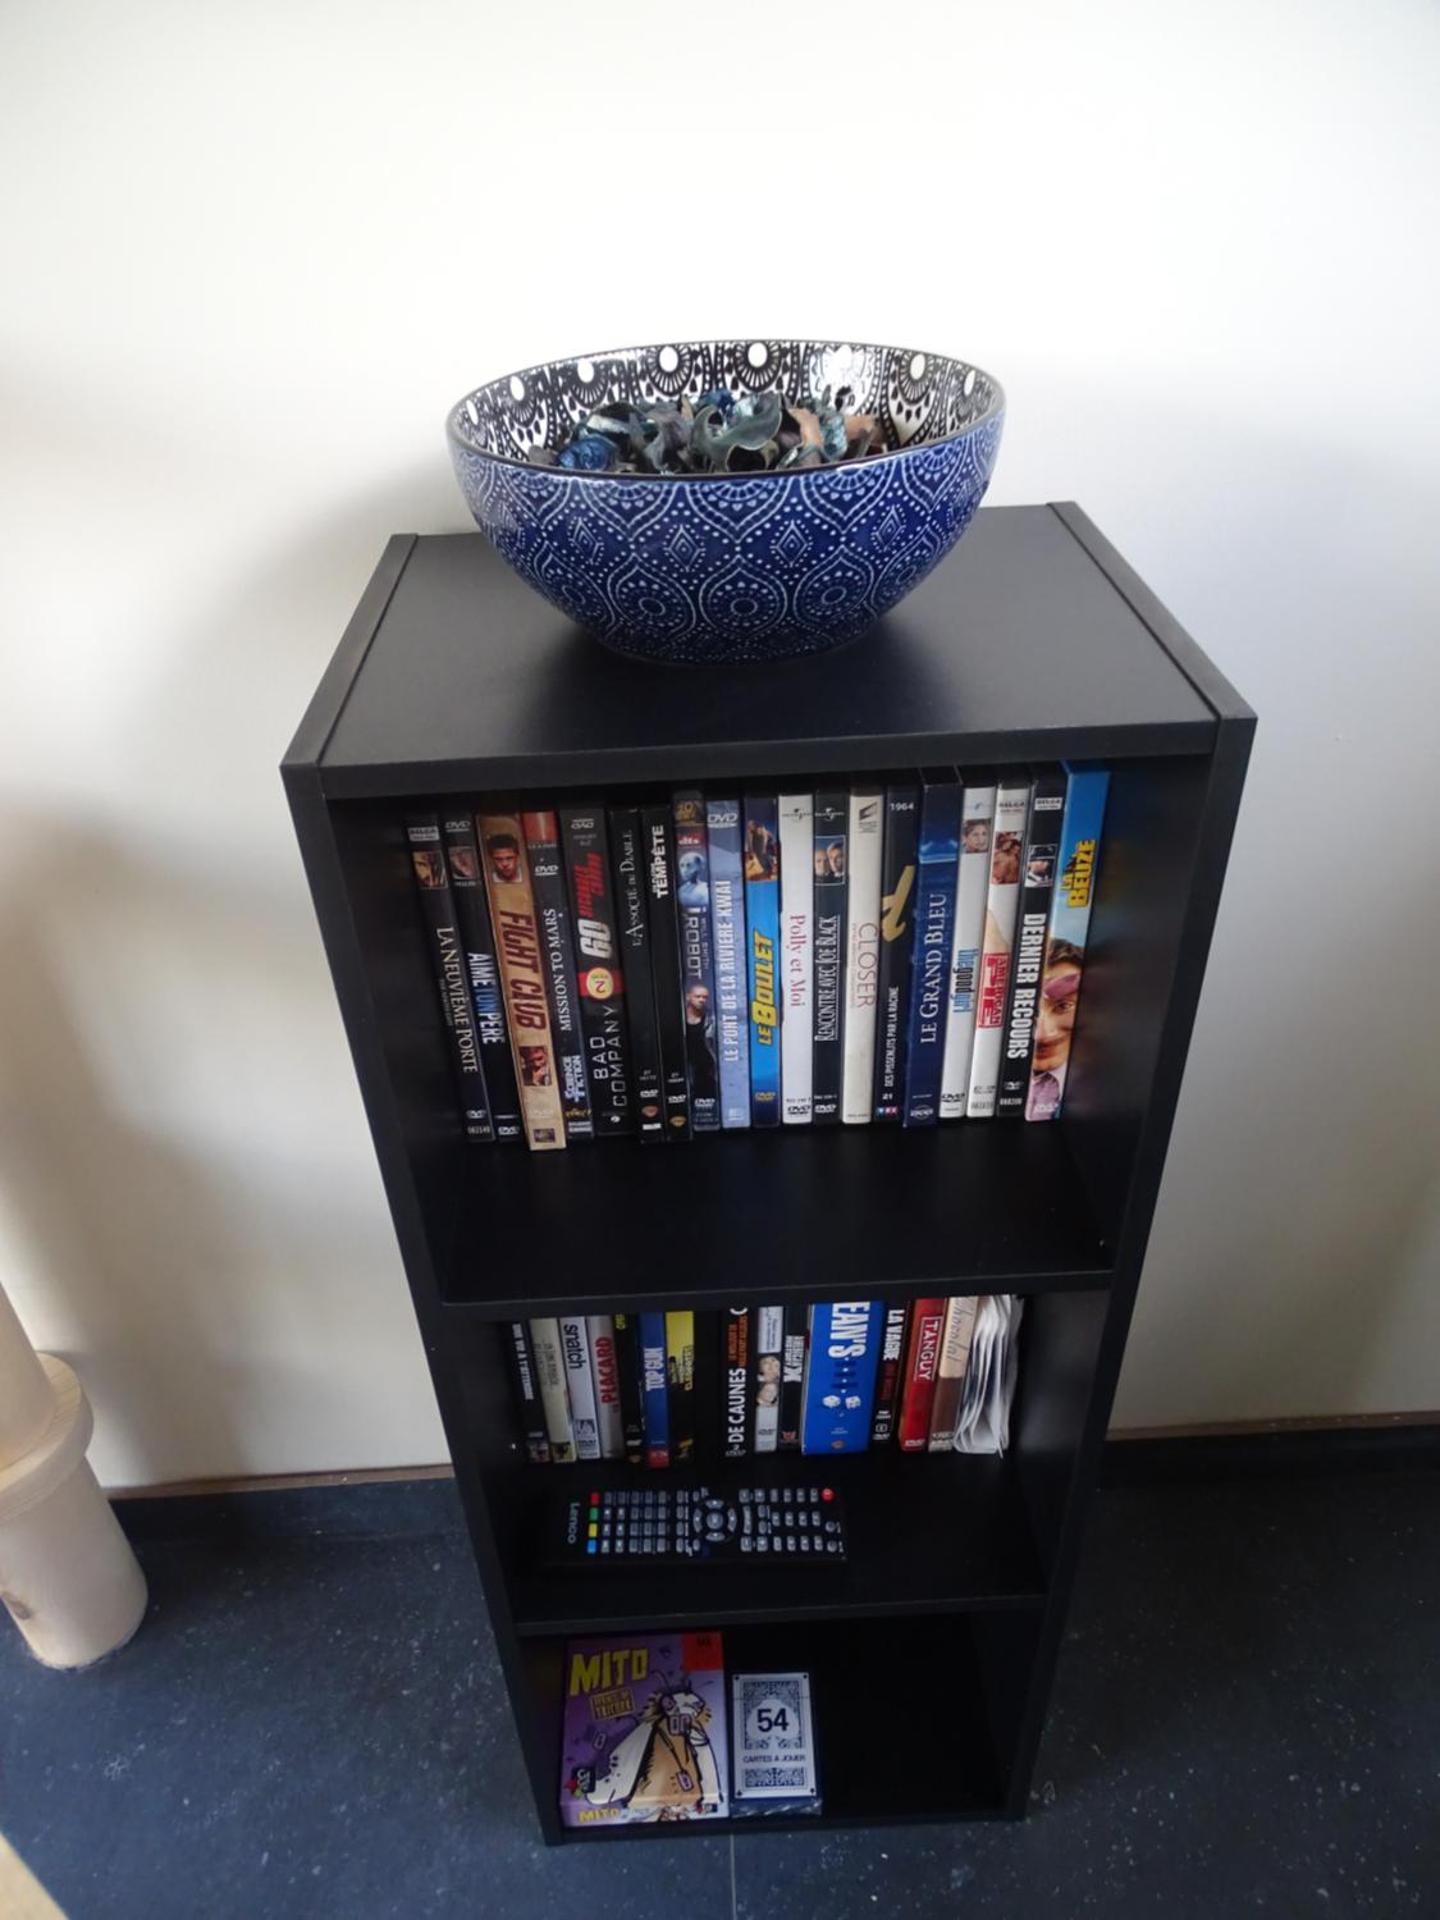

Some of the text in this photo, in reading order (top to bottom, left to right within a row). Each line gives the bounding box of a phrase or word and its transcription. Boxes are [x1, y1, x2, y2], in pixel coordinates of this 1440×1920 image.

[707, 813, 738, 827] DVD
[651, 825, 669, 899] TEMPÊTE
[1067, 839, 1097, 908] BEUZE
[500, 911, 547, 1030] FIGHT CLUB
[543, 909, 572, 1031] MISSION TO MARS
[577, 919, 612, 959] 60
[685, 915, 703, 979] ROBOT
[715, 880, 739, 1062] LE PONT DE LA RIVIERE KWAI
[786, 915, 807, 1007] Polly et Moi
[856, 922, 878, 1008] CLOSER
[920, 894, 947, 1043] LE GRAND BLEU
[1016, 913, 1047, 984] DERNIER
[436, 926, 455, 947] LA
[456, 1028, 478, 1073] PORTE
[595, 980, 606, 993] 2
[751, 930, 778, 1046] LE BOULET
[814, 915, 839, 1042] RENCONTRE AVEC JOE BLACK
[980, 957, 998, 1026] PIE
[993, 955, 1009, 1025] AMERICAN
[590, 1036, 609, 1079] BAD
[602, 1004, 627, 1107] COMPANY
[1007, 988, 1037, 1060] RECOURS
[563, 1323, 587, 1371] snatch
[888, 1309, 906, 1324] LA
[918, 1319, 939, 1382] TANGUY
[595, 1336, 617, 1404] PLACARD
[643, 1346, 665, 1391] TOP GUN
[728, 1368, 747, 1443] DE CAUNES
[570, 1648, 649, 1697] MITO
[757, 1707, 789, 1733] 54
[578, 1807, 620, 1824] MITO
